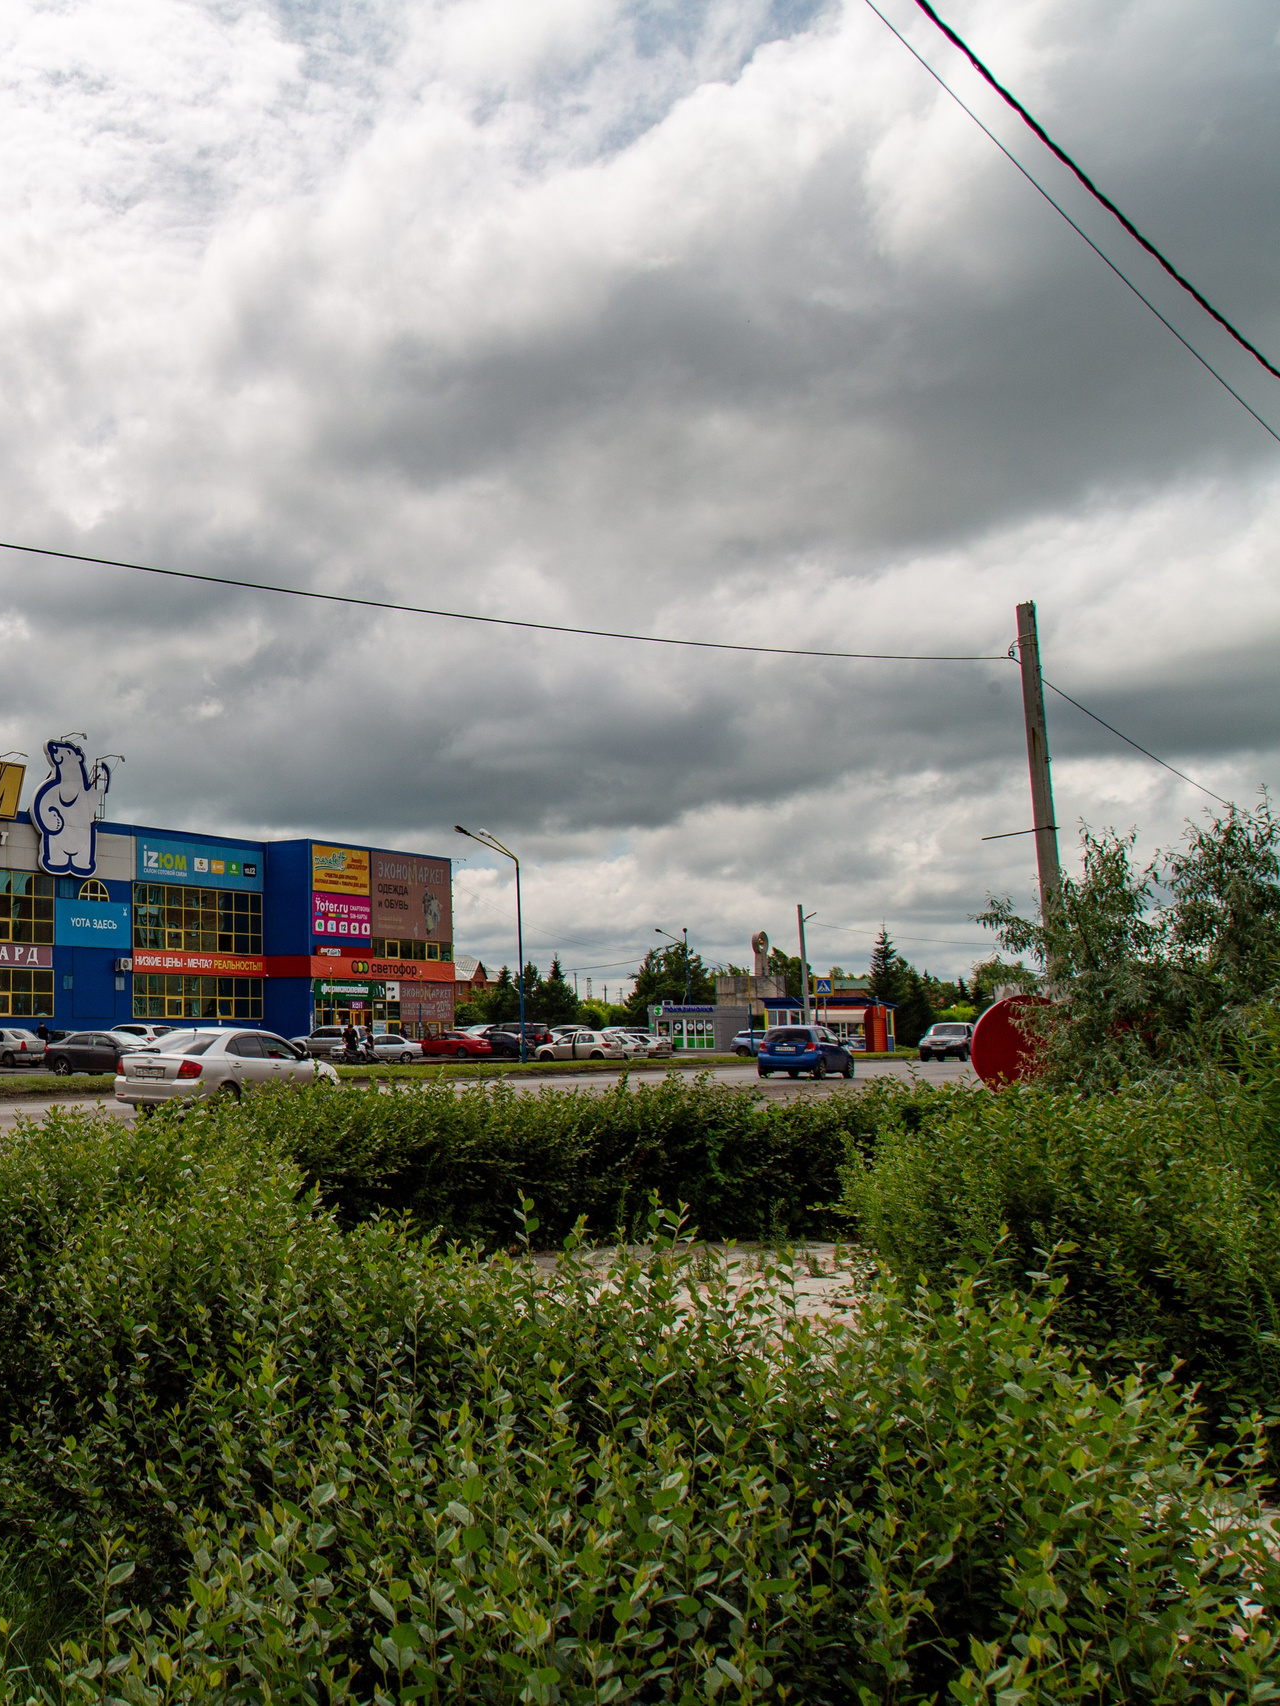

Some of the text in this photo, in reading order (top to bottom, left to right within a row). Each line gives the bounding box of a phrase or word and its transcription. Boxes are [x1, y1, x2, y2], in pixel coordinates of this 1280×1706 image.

[378, 859, 444, 886] ЭКОНОМАРКЕТ
[377, 883, 409, 896] ОДЕЖДА
[384, 899, 409, 910] ОБУВЬ
[70, 916, 118, 931] YOTA ЗДЕСЬ
[135, 955, 162, 967] НИЗКИЕ
[162, 957, 183, 969] ЦЕНЫ
[187, 958, 213, 969] МЕЧТА?
[371, 963, 417, 979] светофор
